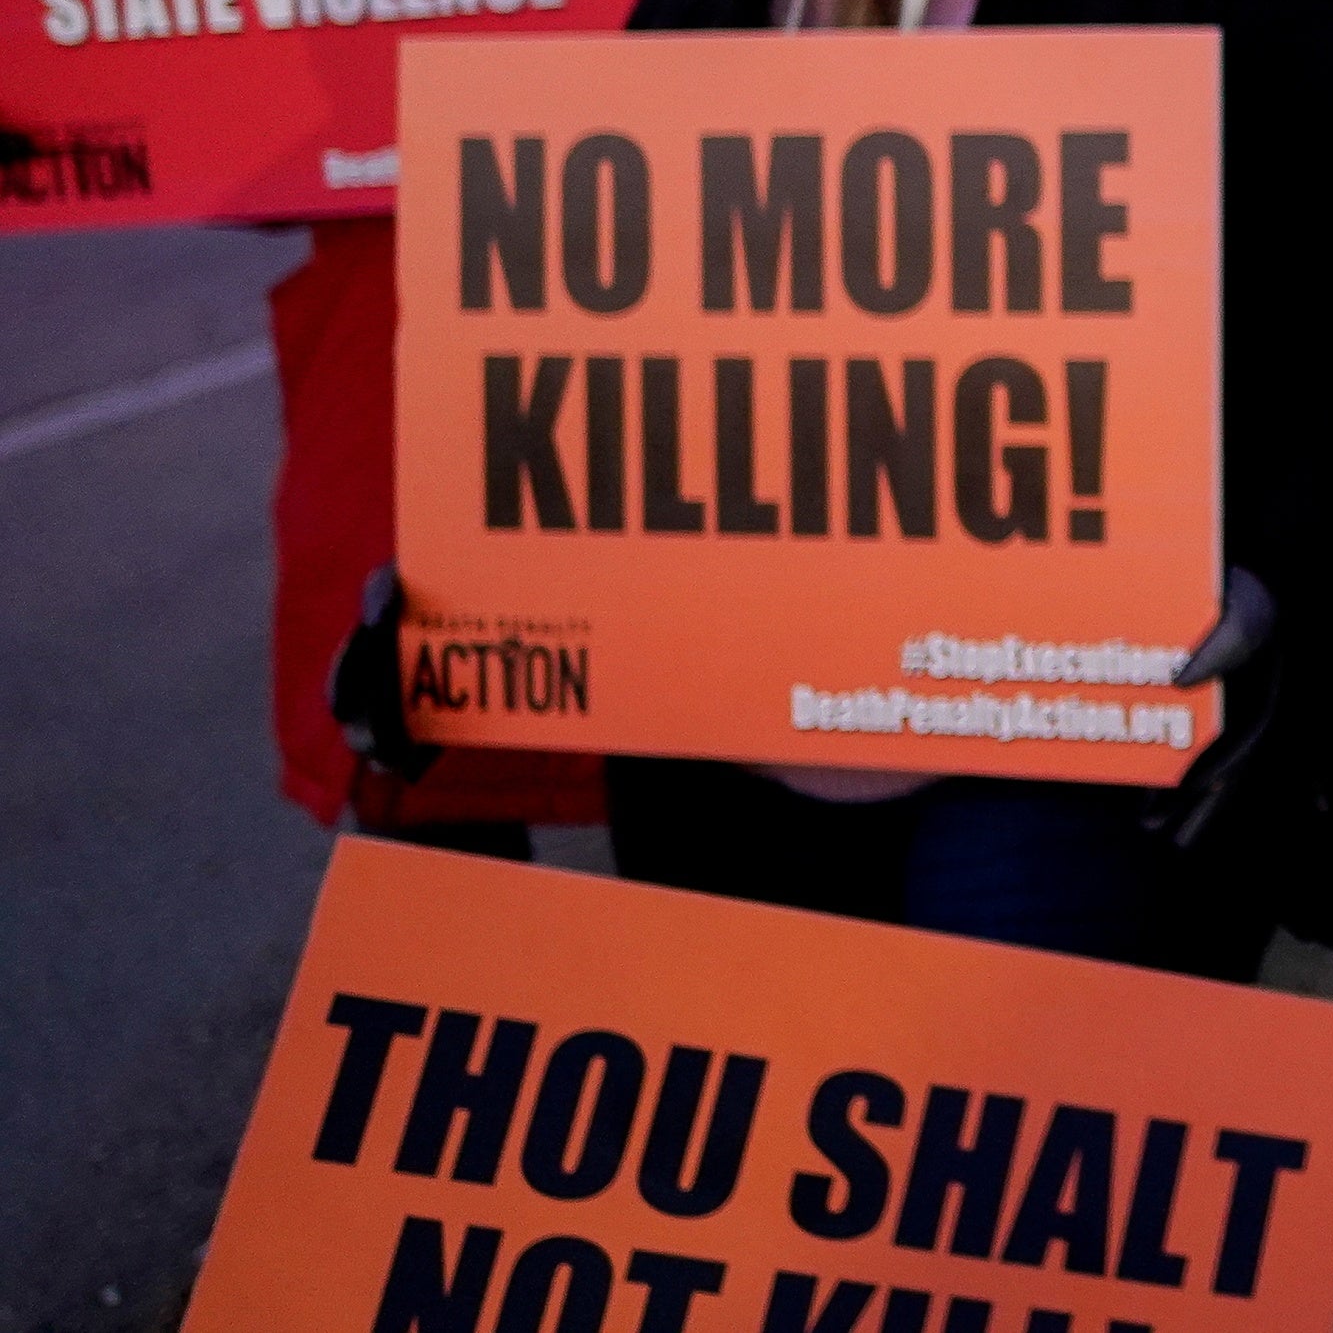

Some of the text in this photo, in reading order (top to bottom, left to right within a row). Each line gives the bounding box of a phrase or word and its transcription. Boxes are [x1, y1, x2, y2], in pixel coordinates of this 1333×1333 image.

[459, 127, 1136, 319] NO MORE
[481, 352, 1111, 545] KILLING!
[410, 636, 590, 715] ACTION
[309, 991, 1311, 1301] THOU SHALT
